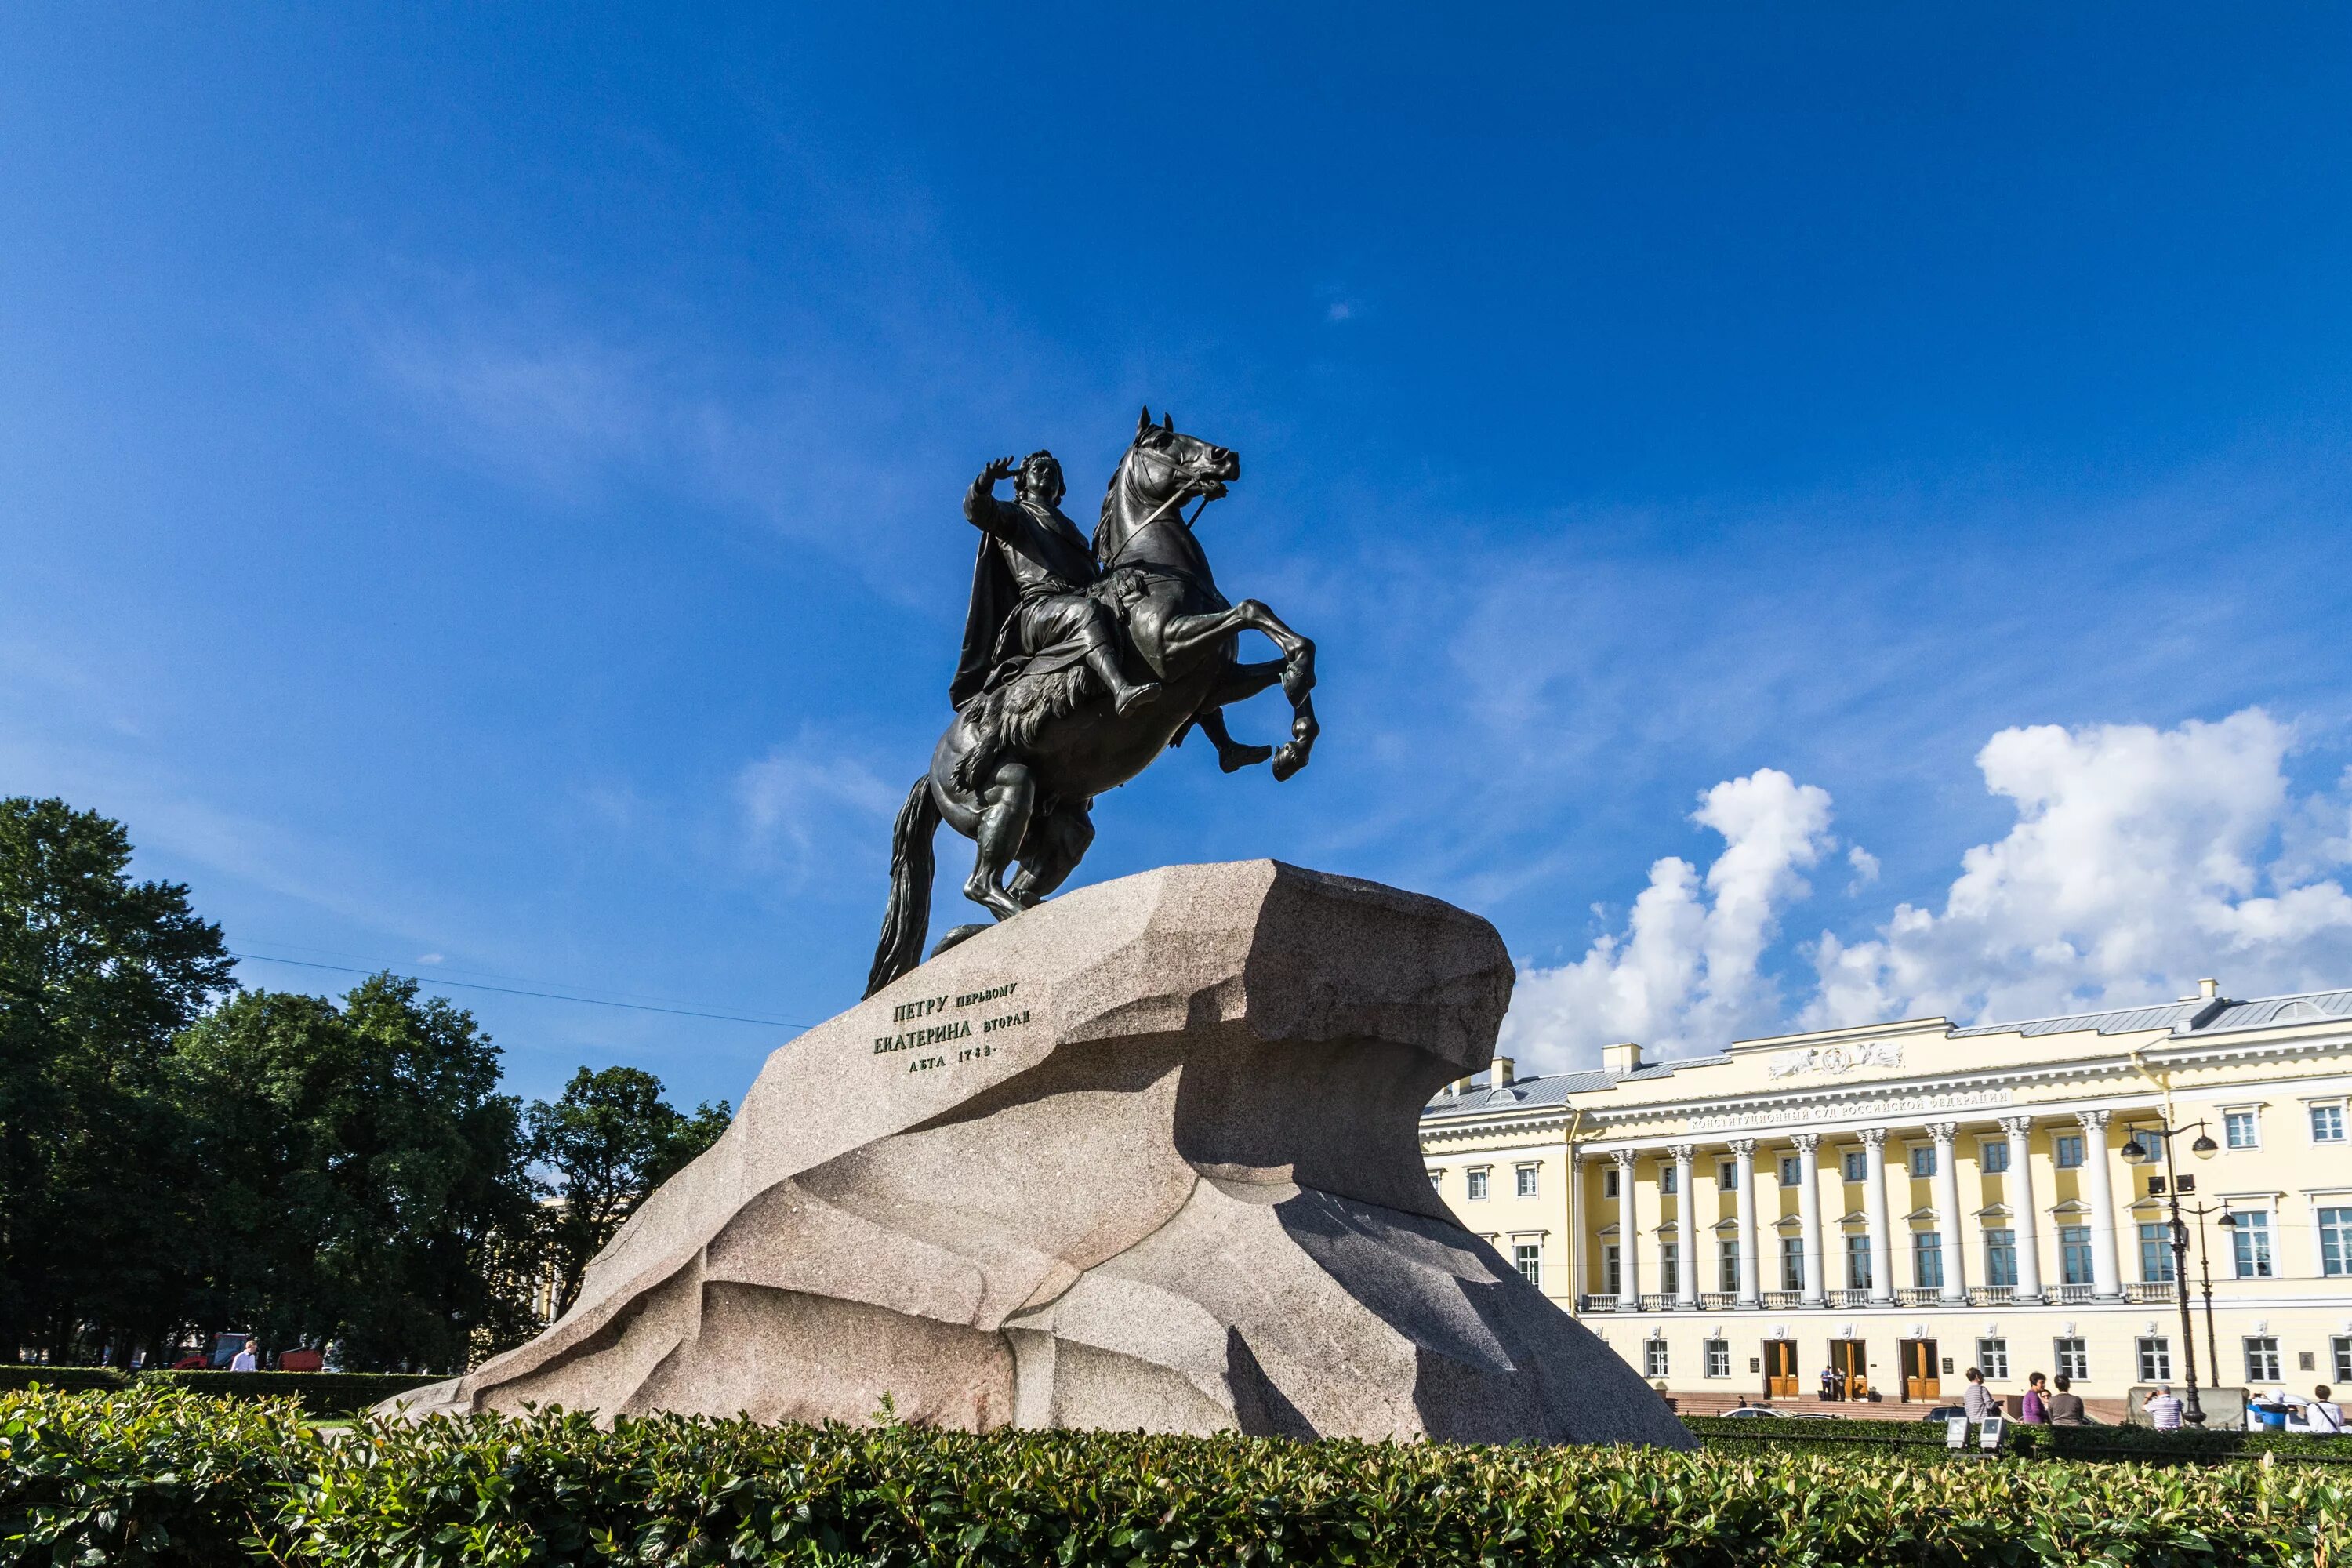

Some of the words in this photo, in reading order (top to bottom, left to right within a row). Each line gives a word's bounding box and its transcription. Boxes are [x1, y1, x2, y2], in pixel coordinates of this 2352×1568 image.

[893, 995, 949, 1022] ПЕТРУ
[956, 982, 1018, 1008] ПЕРЬВОМУ
[873, 1020, 972, 1054] ЕКАТЕРИНА
[1692, 1109, 1809, 1129] КОНСТИТУЦИОННЫЙ
[1814, 1108, 1837, 1119] СУД
[1842, 1098, 1925, 1116] РОССИЙСКОЙ
[1929, 1092, 2008, 1109] ФЕДЕРАЦИИ
